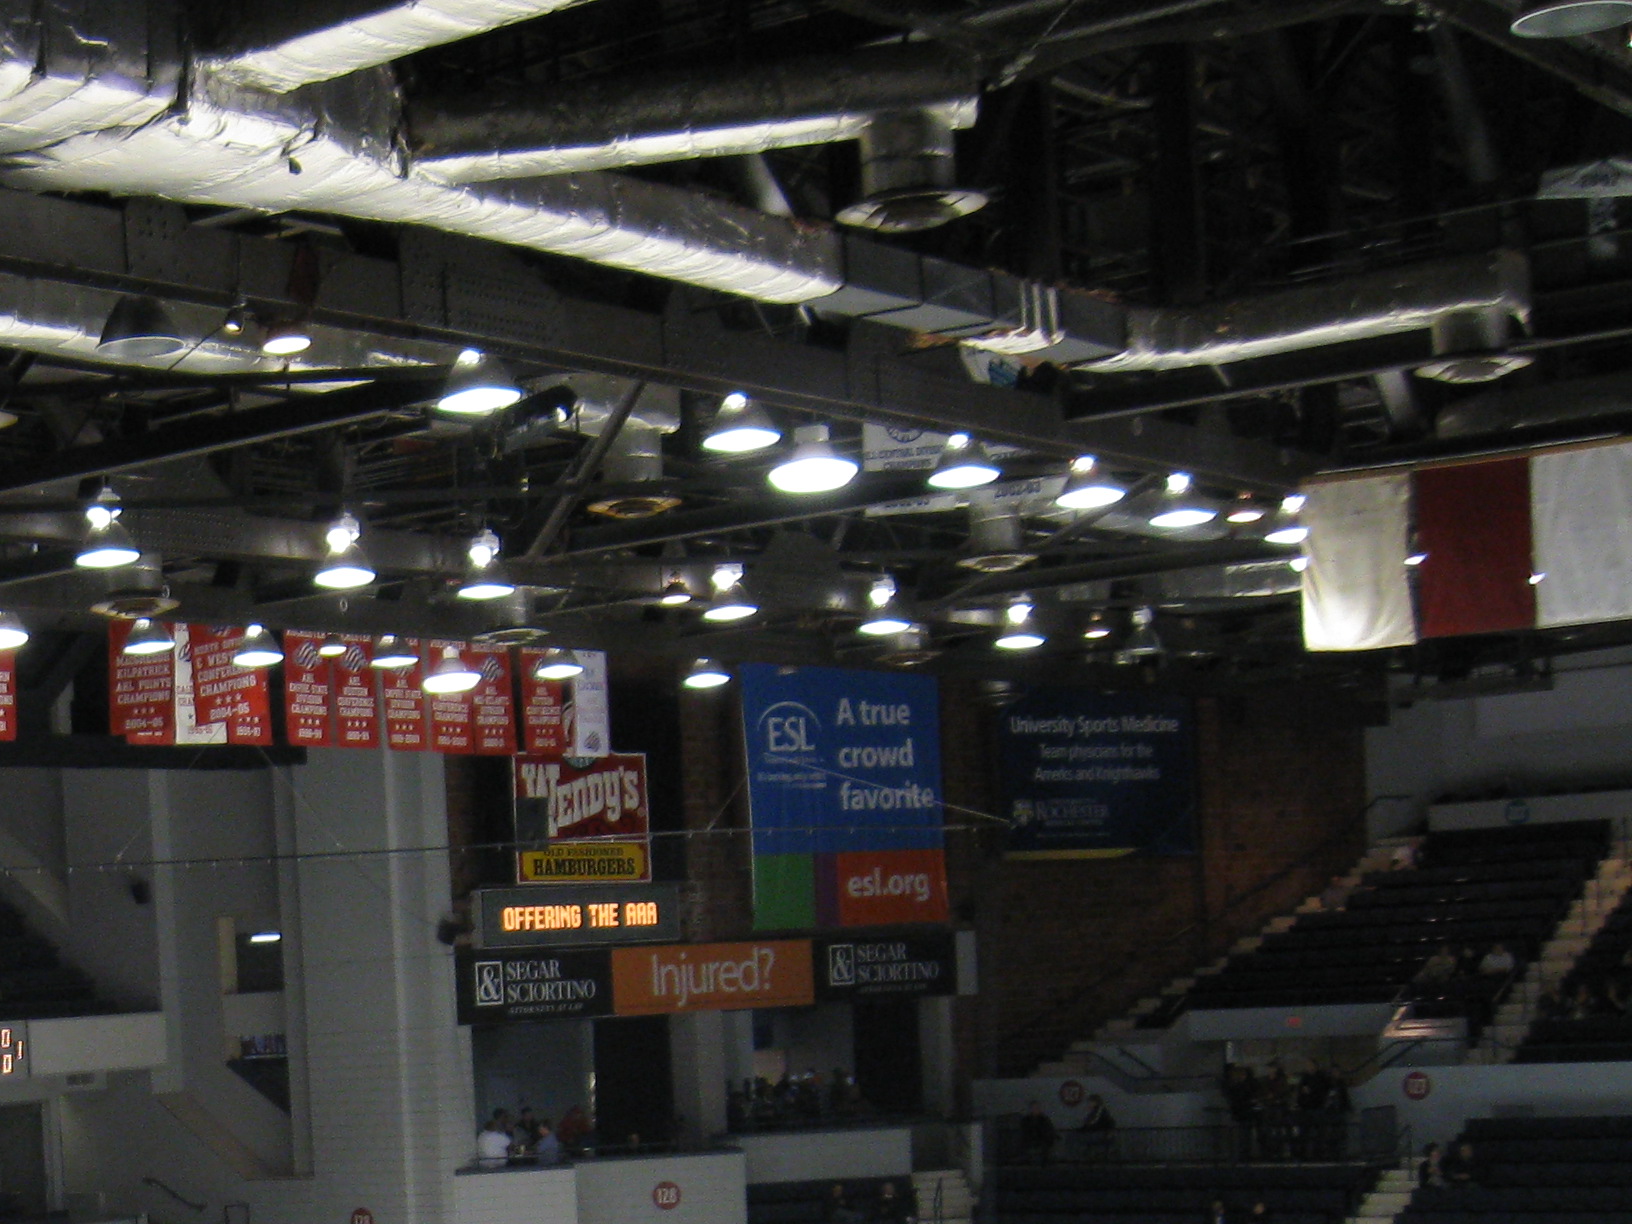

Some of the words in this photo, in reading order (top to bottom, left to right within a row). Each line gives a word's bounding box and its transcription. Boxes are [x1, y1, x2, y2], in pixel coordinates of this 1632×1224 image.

[837, 698, 857, 726] A
[859, 700, 911, 726] true
[768, 717, 815, 751] ESL
[1009, 715, 1075, 738] University
[838, 738, 914, 768] crowd
[840, 779, 935, 810] favorite
[533, 857, 635, 876] HAMBURGERS
[848, 867, 930, 901] esl.org
[503, 904, 582, 931] OFFERING
[588, 903, 619, 928] THE
[626, 902, 658, 926] AAA
[857, 942, 907, 961] SEGAR
[507, 959, 561, 981] SEGAR
[651, 947, 775, 1007] Injured?
[857, 962, 940, 983] SCIORTINO
[507, 979, 597, 1003] SCIORTINO
